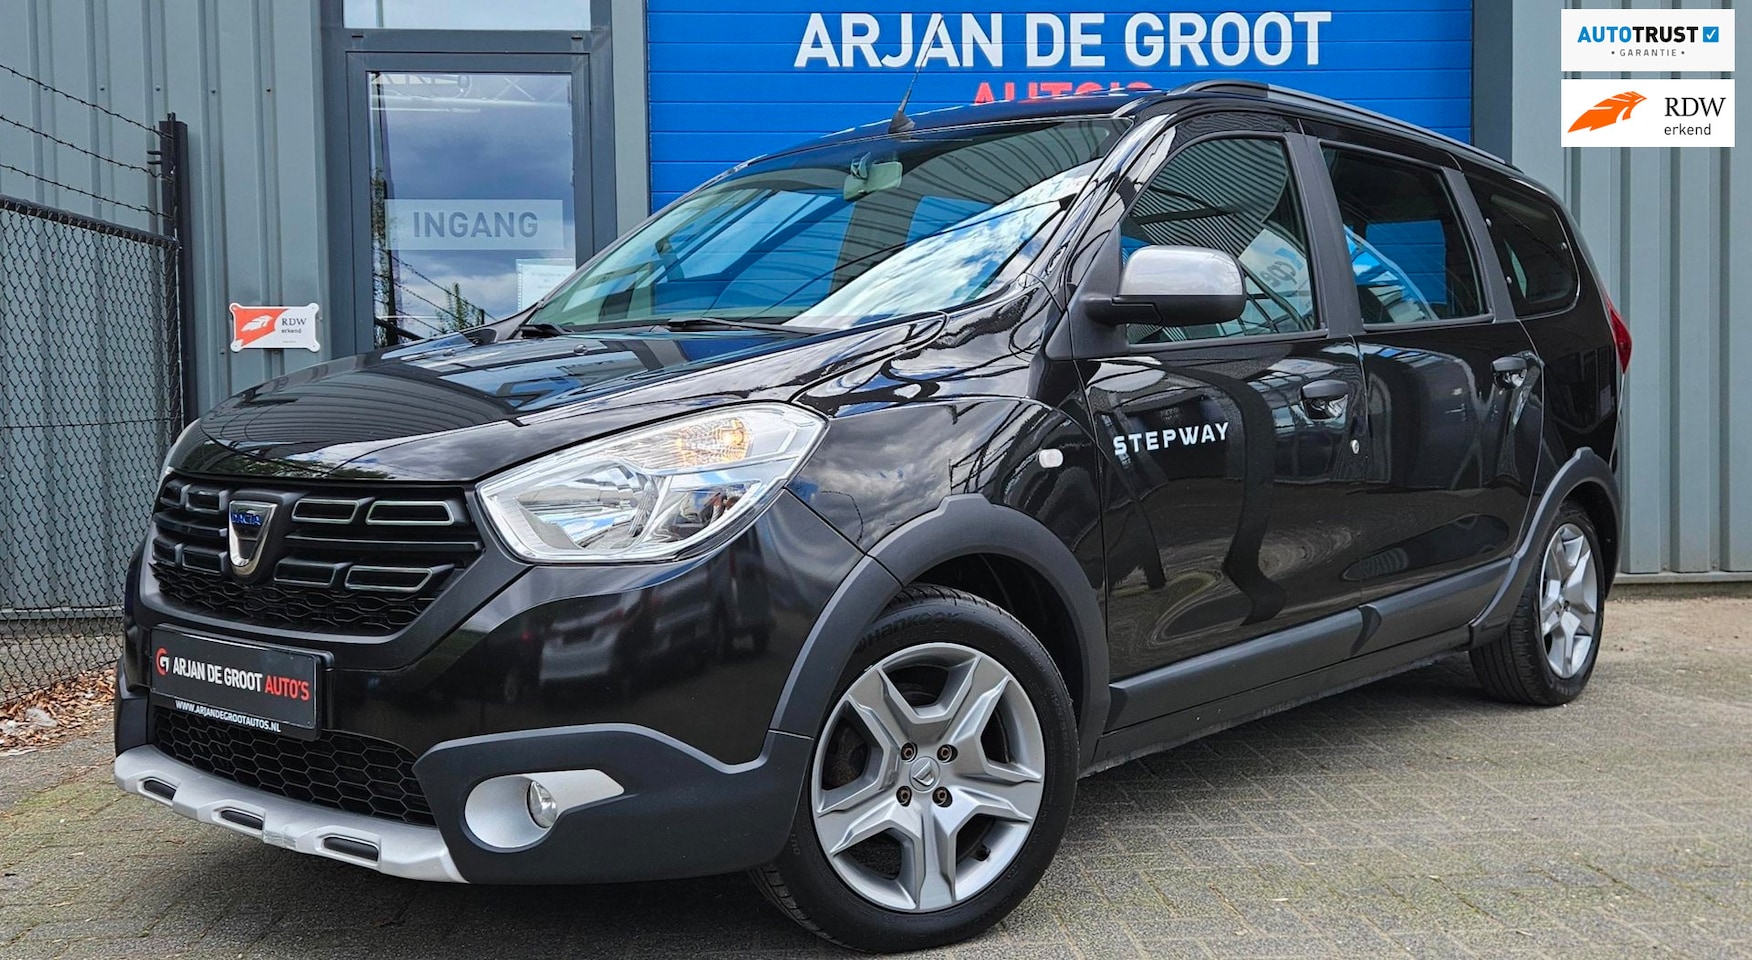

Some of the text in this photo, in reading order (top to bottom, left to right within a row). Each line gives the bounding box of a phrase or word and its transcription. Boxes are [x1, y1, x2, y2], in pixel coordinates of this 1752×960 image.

[794, 11, 1332, 67] ARJAN DE GROOT
[413, 211, 539, 238] INGANG
[281, 317, 307, 326] RDW
[1113, 422, 1229, 455] STEPWAY
[173, 657, 309, 700] ARJAN DE GROOT AUTO'S
[175, 700, 281, 732] WWW.ARJANDEGROOTAUTOS.NL
